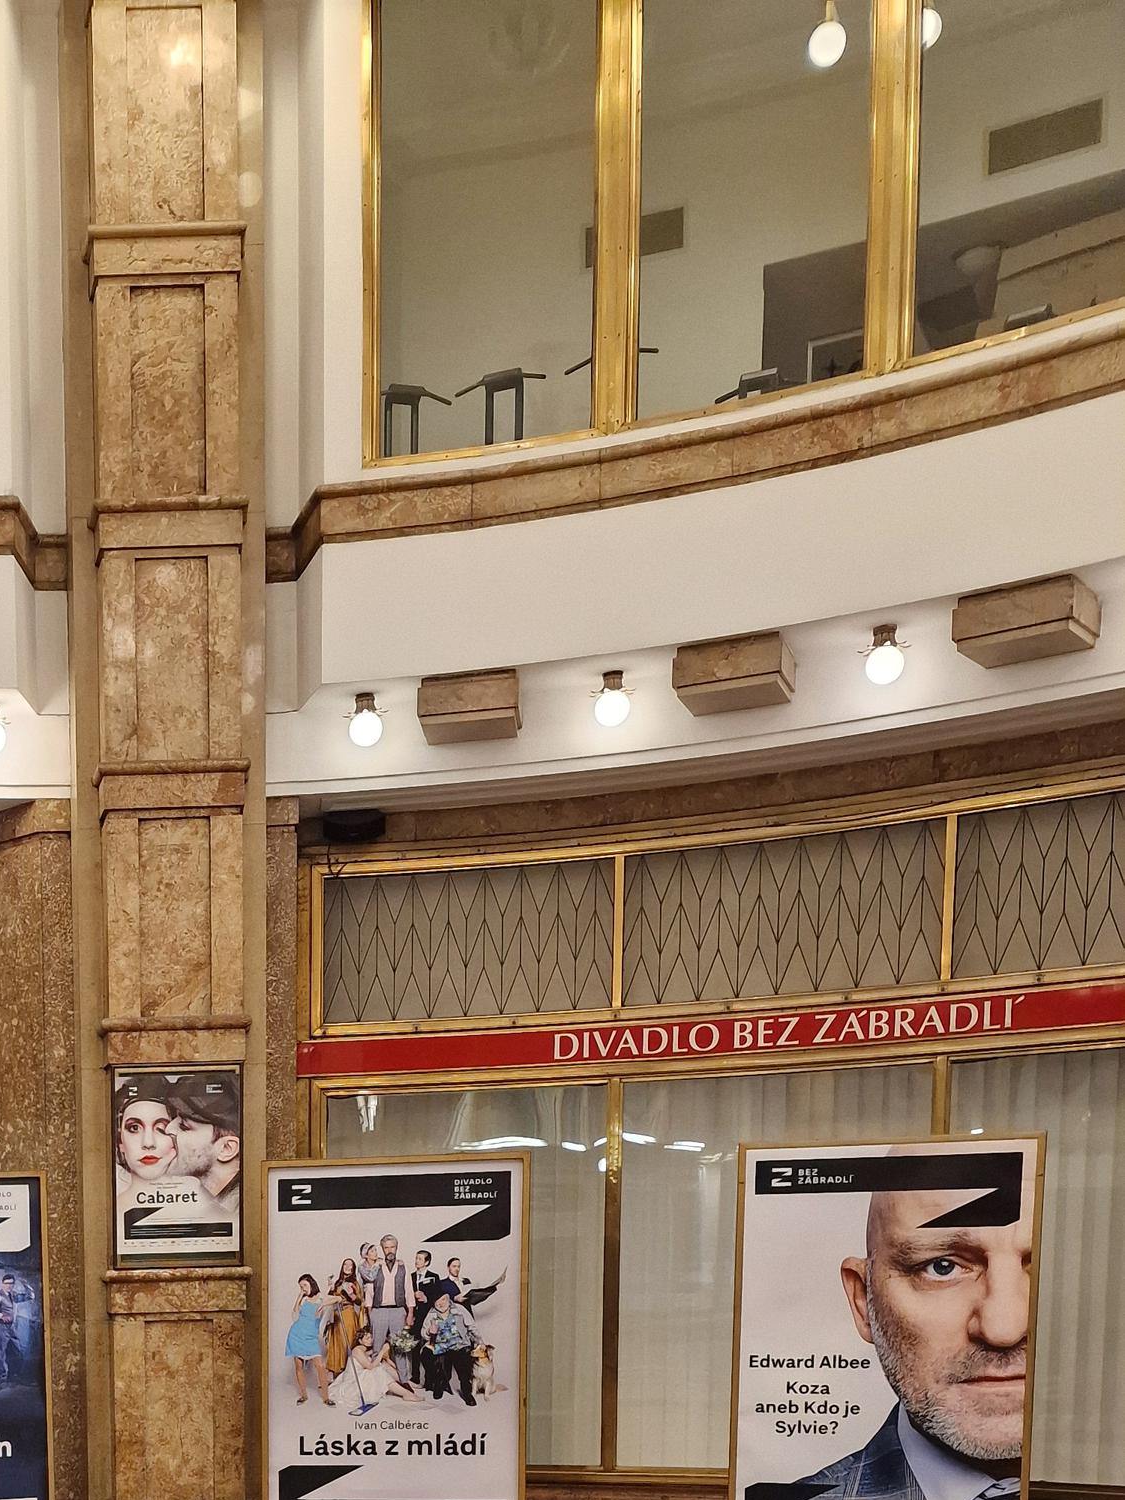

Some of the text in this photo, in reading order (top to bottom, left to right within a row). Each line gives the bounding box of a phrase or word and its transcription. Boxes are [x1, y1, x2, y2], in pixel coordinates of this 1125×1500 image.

[553, 995, 1025, 1060] DIVADLO BEZ ZÁBRADLÍ
[798, 1168, 819, 1177] BEZ
[454, 1178, 493, 1186] DIVADLO
[797, 1174, 855, 1185] ZÁBRADLÍ
[137, 1191, 198, 1204] Cabaret
[453, 1191, 498, 1200] ZÁBRADLÍ
[749, 1354, 871, 1369] Edward Albee
[786, 1381, 830, 1395] Koza
[755, 1400, 861, 1418] aneb Kdo je
[354, 1420, 429, 1430] Ivan Calbérac
[775, 1420, 839, 1437] Sylvie?
[299, 1433, 487, 1456] Láska z mládí
